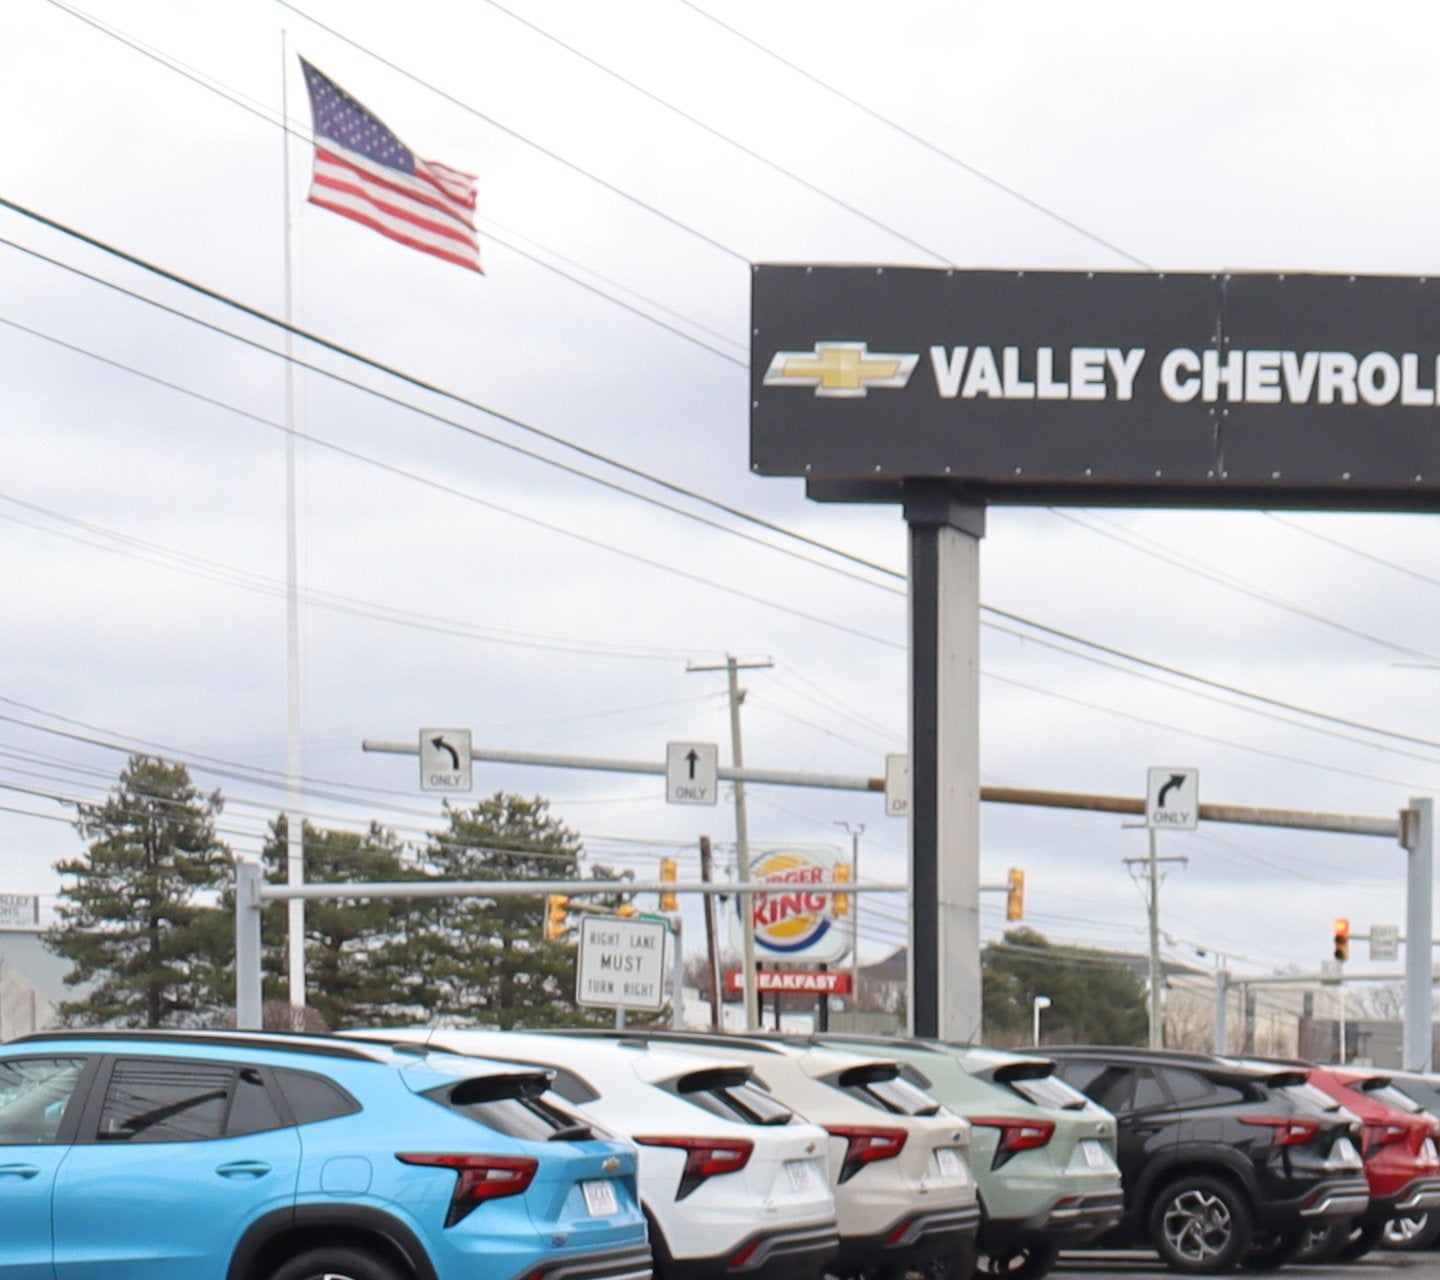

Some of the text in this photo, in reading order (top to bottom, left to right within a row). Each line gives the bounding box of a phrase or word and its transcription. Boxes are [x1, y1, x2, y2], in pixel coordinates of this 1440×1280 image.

[929, 345, 1146, 401] VALLEY
[430, 775, 462, 787] ONLY
[675, 787, 707, 799] ONLY
[1153, 811, 1189, 823] ONLY
[590, 931, 656, 949] RIGHT LANE
[600, 954, 643, 972] MUST
[588, 979, 654, 997] TURN RIGHT
[734, 973, 837, 990] BEAKFAST
